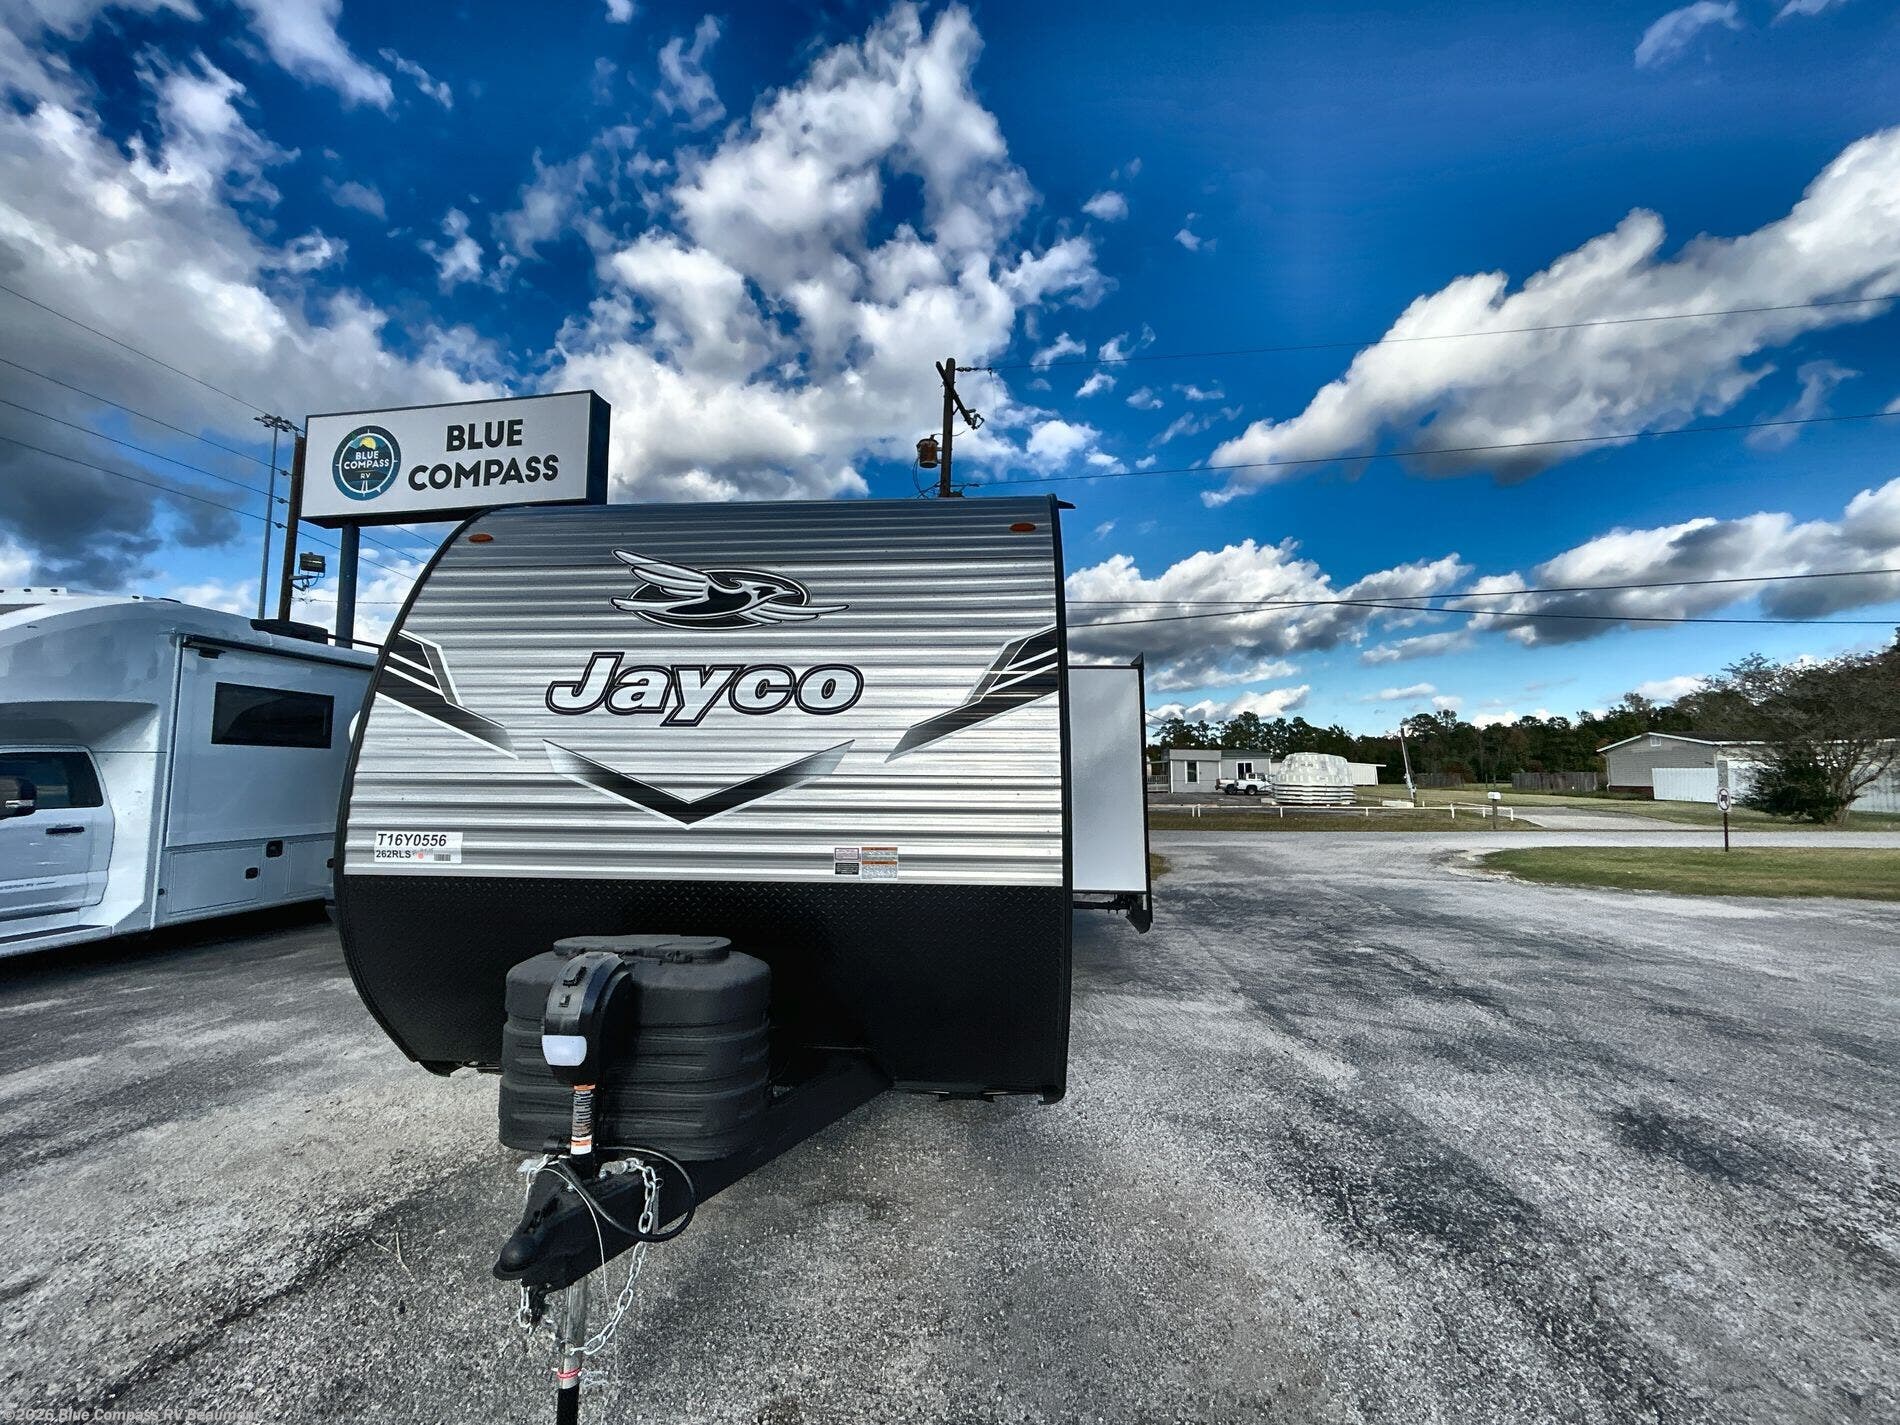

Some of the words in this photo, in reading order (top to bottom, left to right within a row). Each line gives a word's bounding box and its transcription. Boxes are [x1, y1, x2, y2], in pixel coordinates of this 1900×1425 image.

[446, 419, 523, 452] BLUE
[355, 451, 379, 461] BLUE
[343, 458, 390, 470] COMPASS
[360, 472, 371, 480] RV
[408, 454, 560, 491] COMPASS
[545, 652, 865, 727] Jayco
[378, 833, 447, 847] T16Y0556
[375, 849, 412, 859] 262RLS
